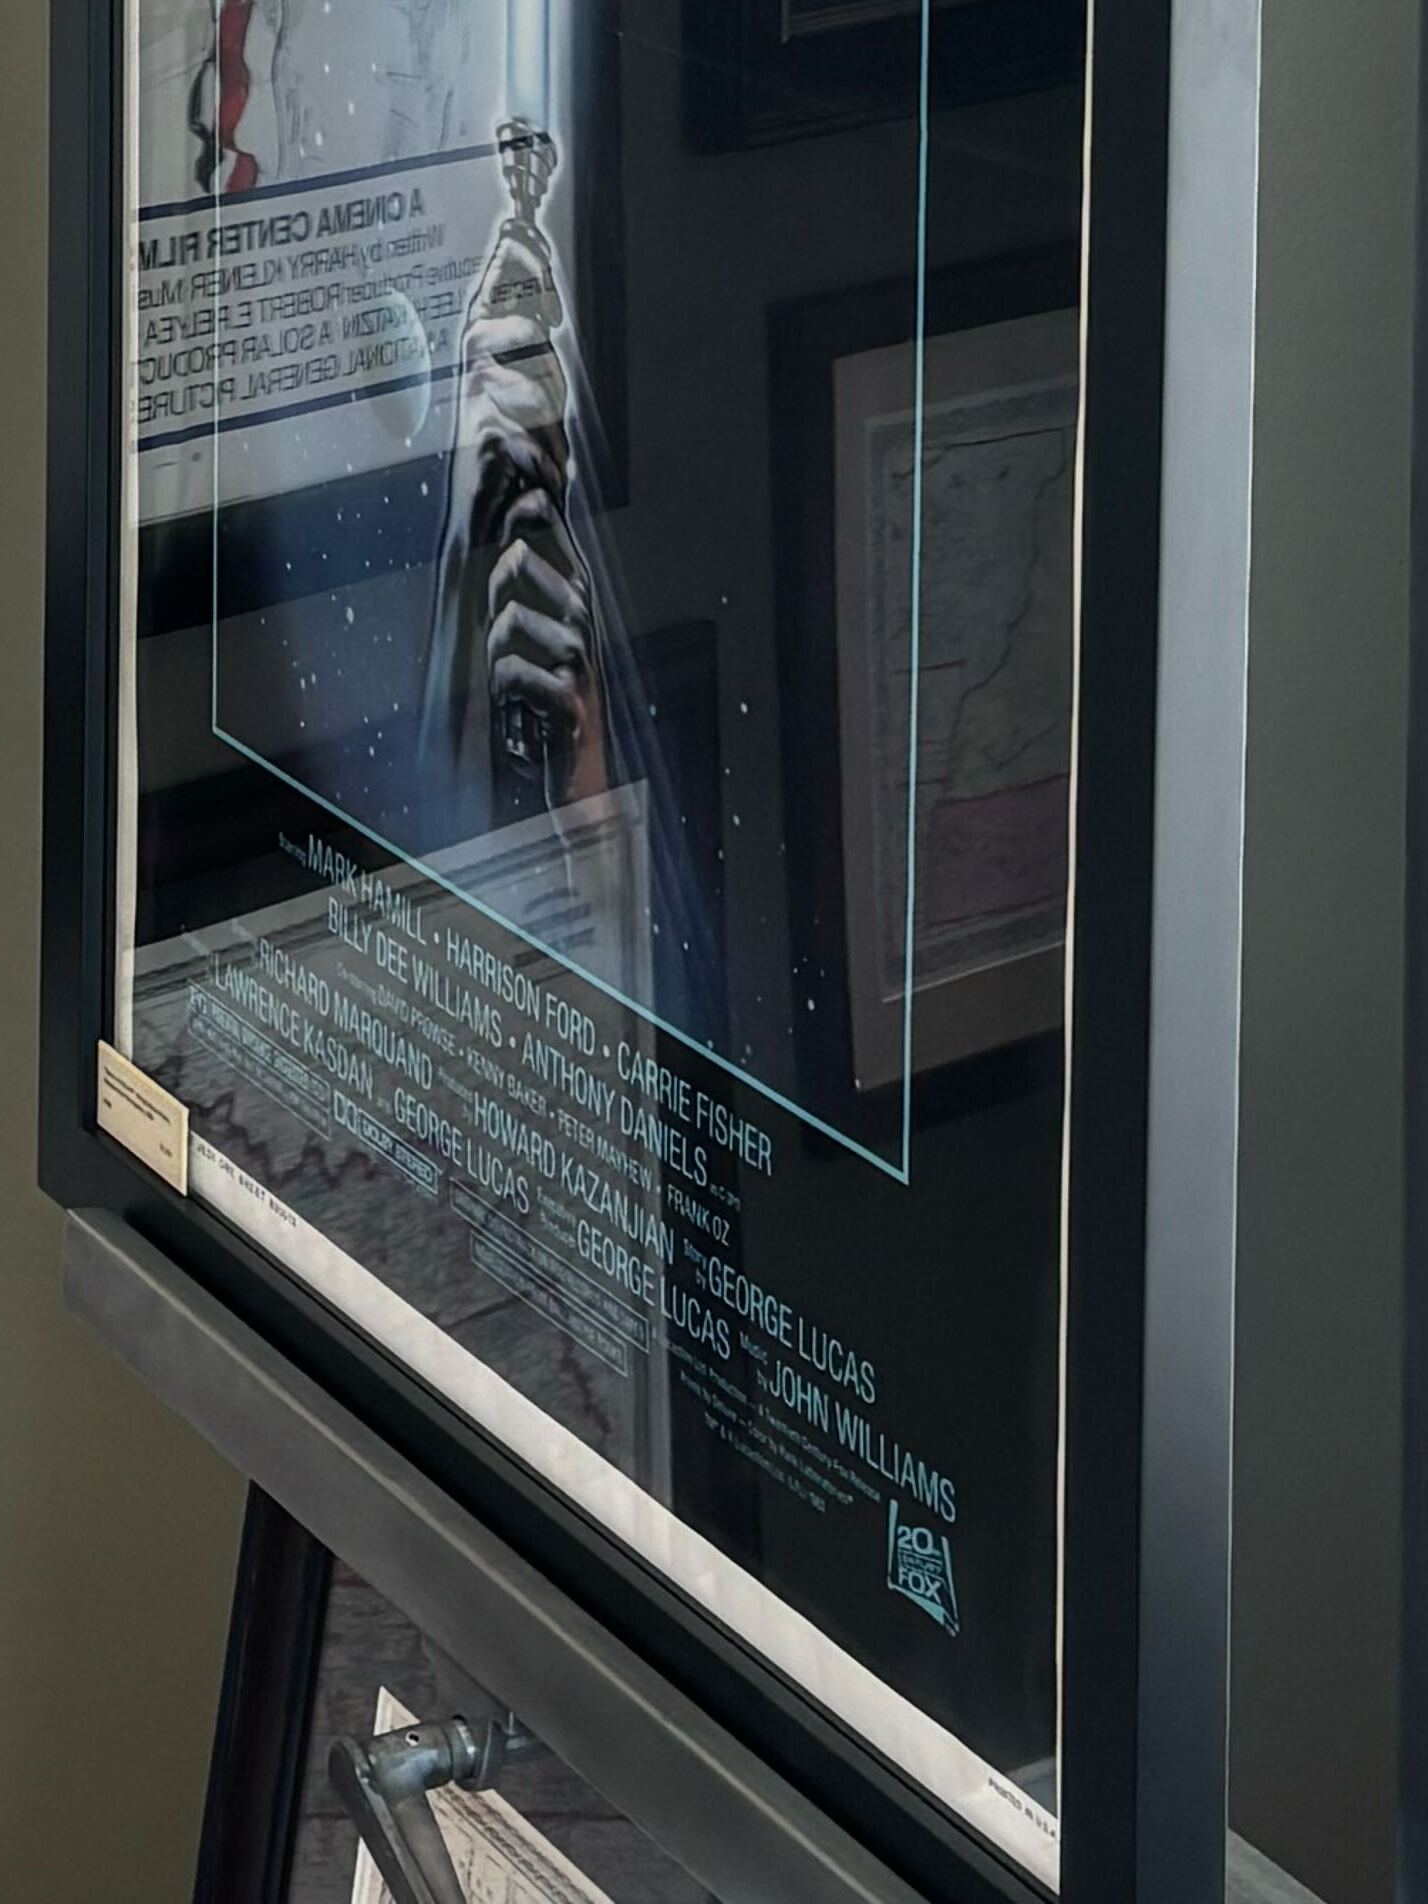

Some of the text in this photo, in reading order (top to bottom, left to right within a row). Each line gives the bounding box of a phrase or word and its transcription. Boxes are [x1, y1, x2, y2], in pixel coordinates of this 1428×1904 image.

[308, 834, 357, 897] MARK
[360, 871, 426, 945] HAMILL
[447, 928, 540, 1021] HARRISON
[546, 992, 595, 1056] FORD
[617, 1042, 691, 1122] CARRIE
[697, 1091, 772, 1176] FISHER
[328, 897, 373, 955] BILLY
[376, 931, 408, 984] DEE
[413, 956, 503, 1049] WILLIAMS
[522, 1032, 615, 1124] ANTHONY
[620, 1096, 708, 1187] DANIELS
[214, 954, 299, 1047] LAWRENCE
[304, 1018, 373, 1100] KASDAN
[394, 1088, 462, 1167] GEORGE
[467, 1139, 530, 1214] LUCAS
[578, 1219, 655, 1307] GEORGE
[660, 1276, 730, 1360] LUCAS
[769, 1360, 829, 1433] JOHN
[835, 1401, 956, 1523] WILLIAMS
[260, 939, 330, 1016] RICHARD
[334, 991, 432, 1089] MARQUAND
[474, 1092, 555, 1178] HOWARD
[561, 1152, 675, 1266] KAZANJIAN
[708, 1256, 793, 1348] GEORGE
[799, 1317, 876, 1403] LUCAS
[667, 1184, 710, 1233] FRANK
[713, 1216, 730, 1246] OZ
[897, 1526, 941, 1557] 20
[899, 1567, 943, 1603] FOX
